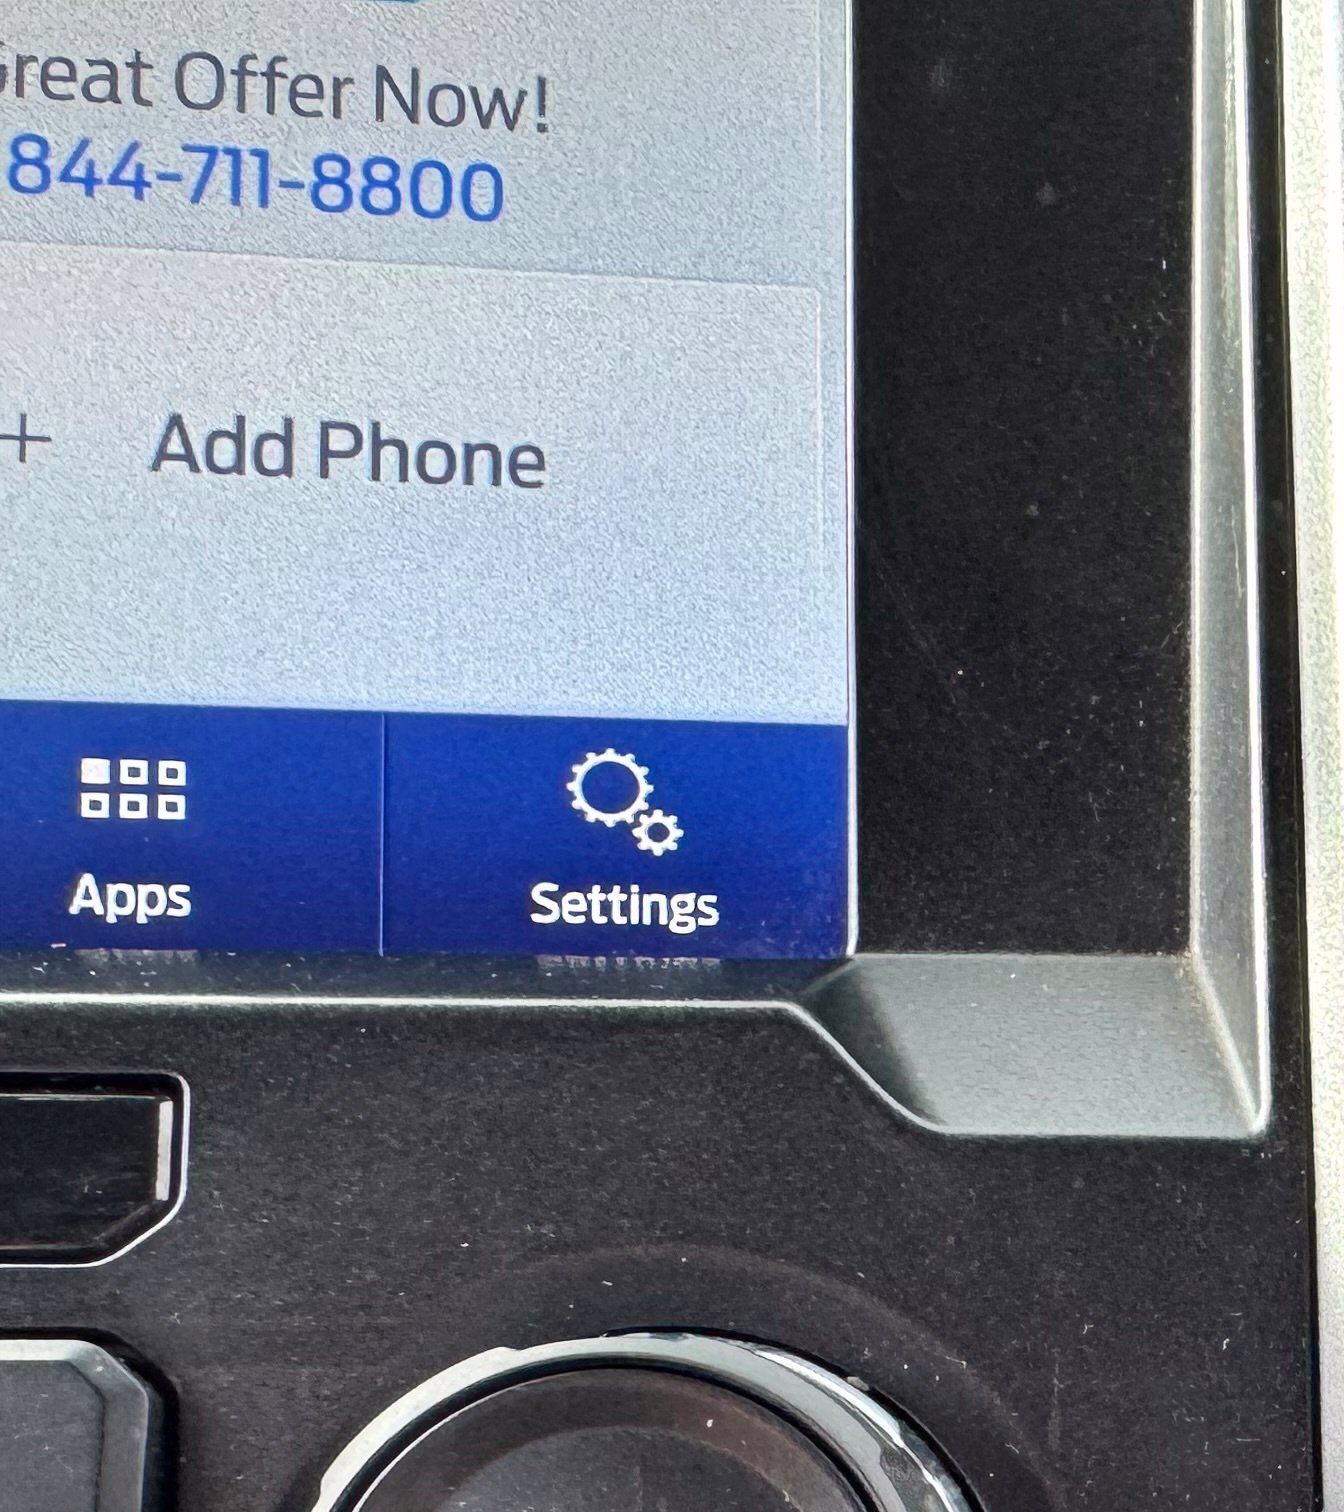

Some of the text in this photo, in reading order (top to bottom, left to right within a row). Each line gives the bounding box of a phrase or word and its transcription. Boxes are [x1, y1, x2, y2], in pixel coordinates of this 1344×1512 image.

[172, 50, 354, 120] Offer
[374, 64, 550, 134] Now!
[150, 412, 547, 489] Add Phone
[68, 872, 192, 925] Apps
[529, 882, 720, 934] Settings
